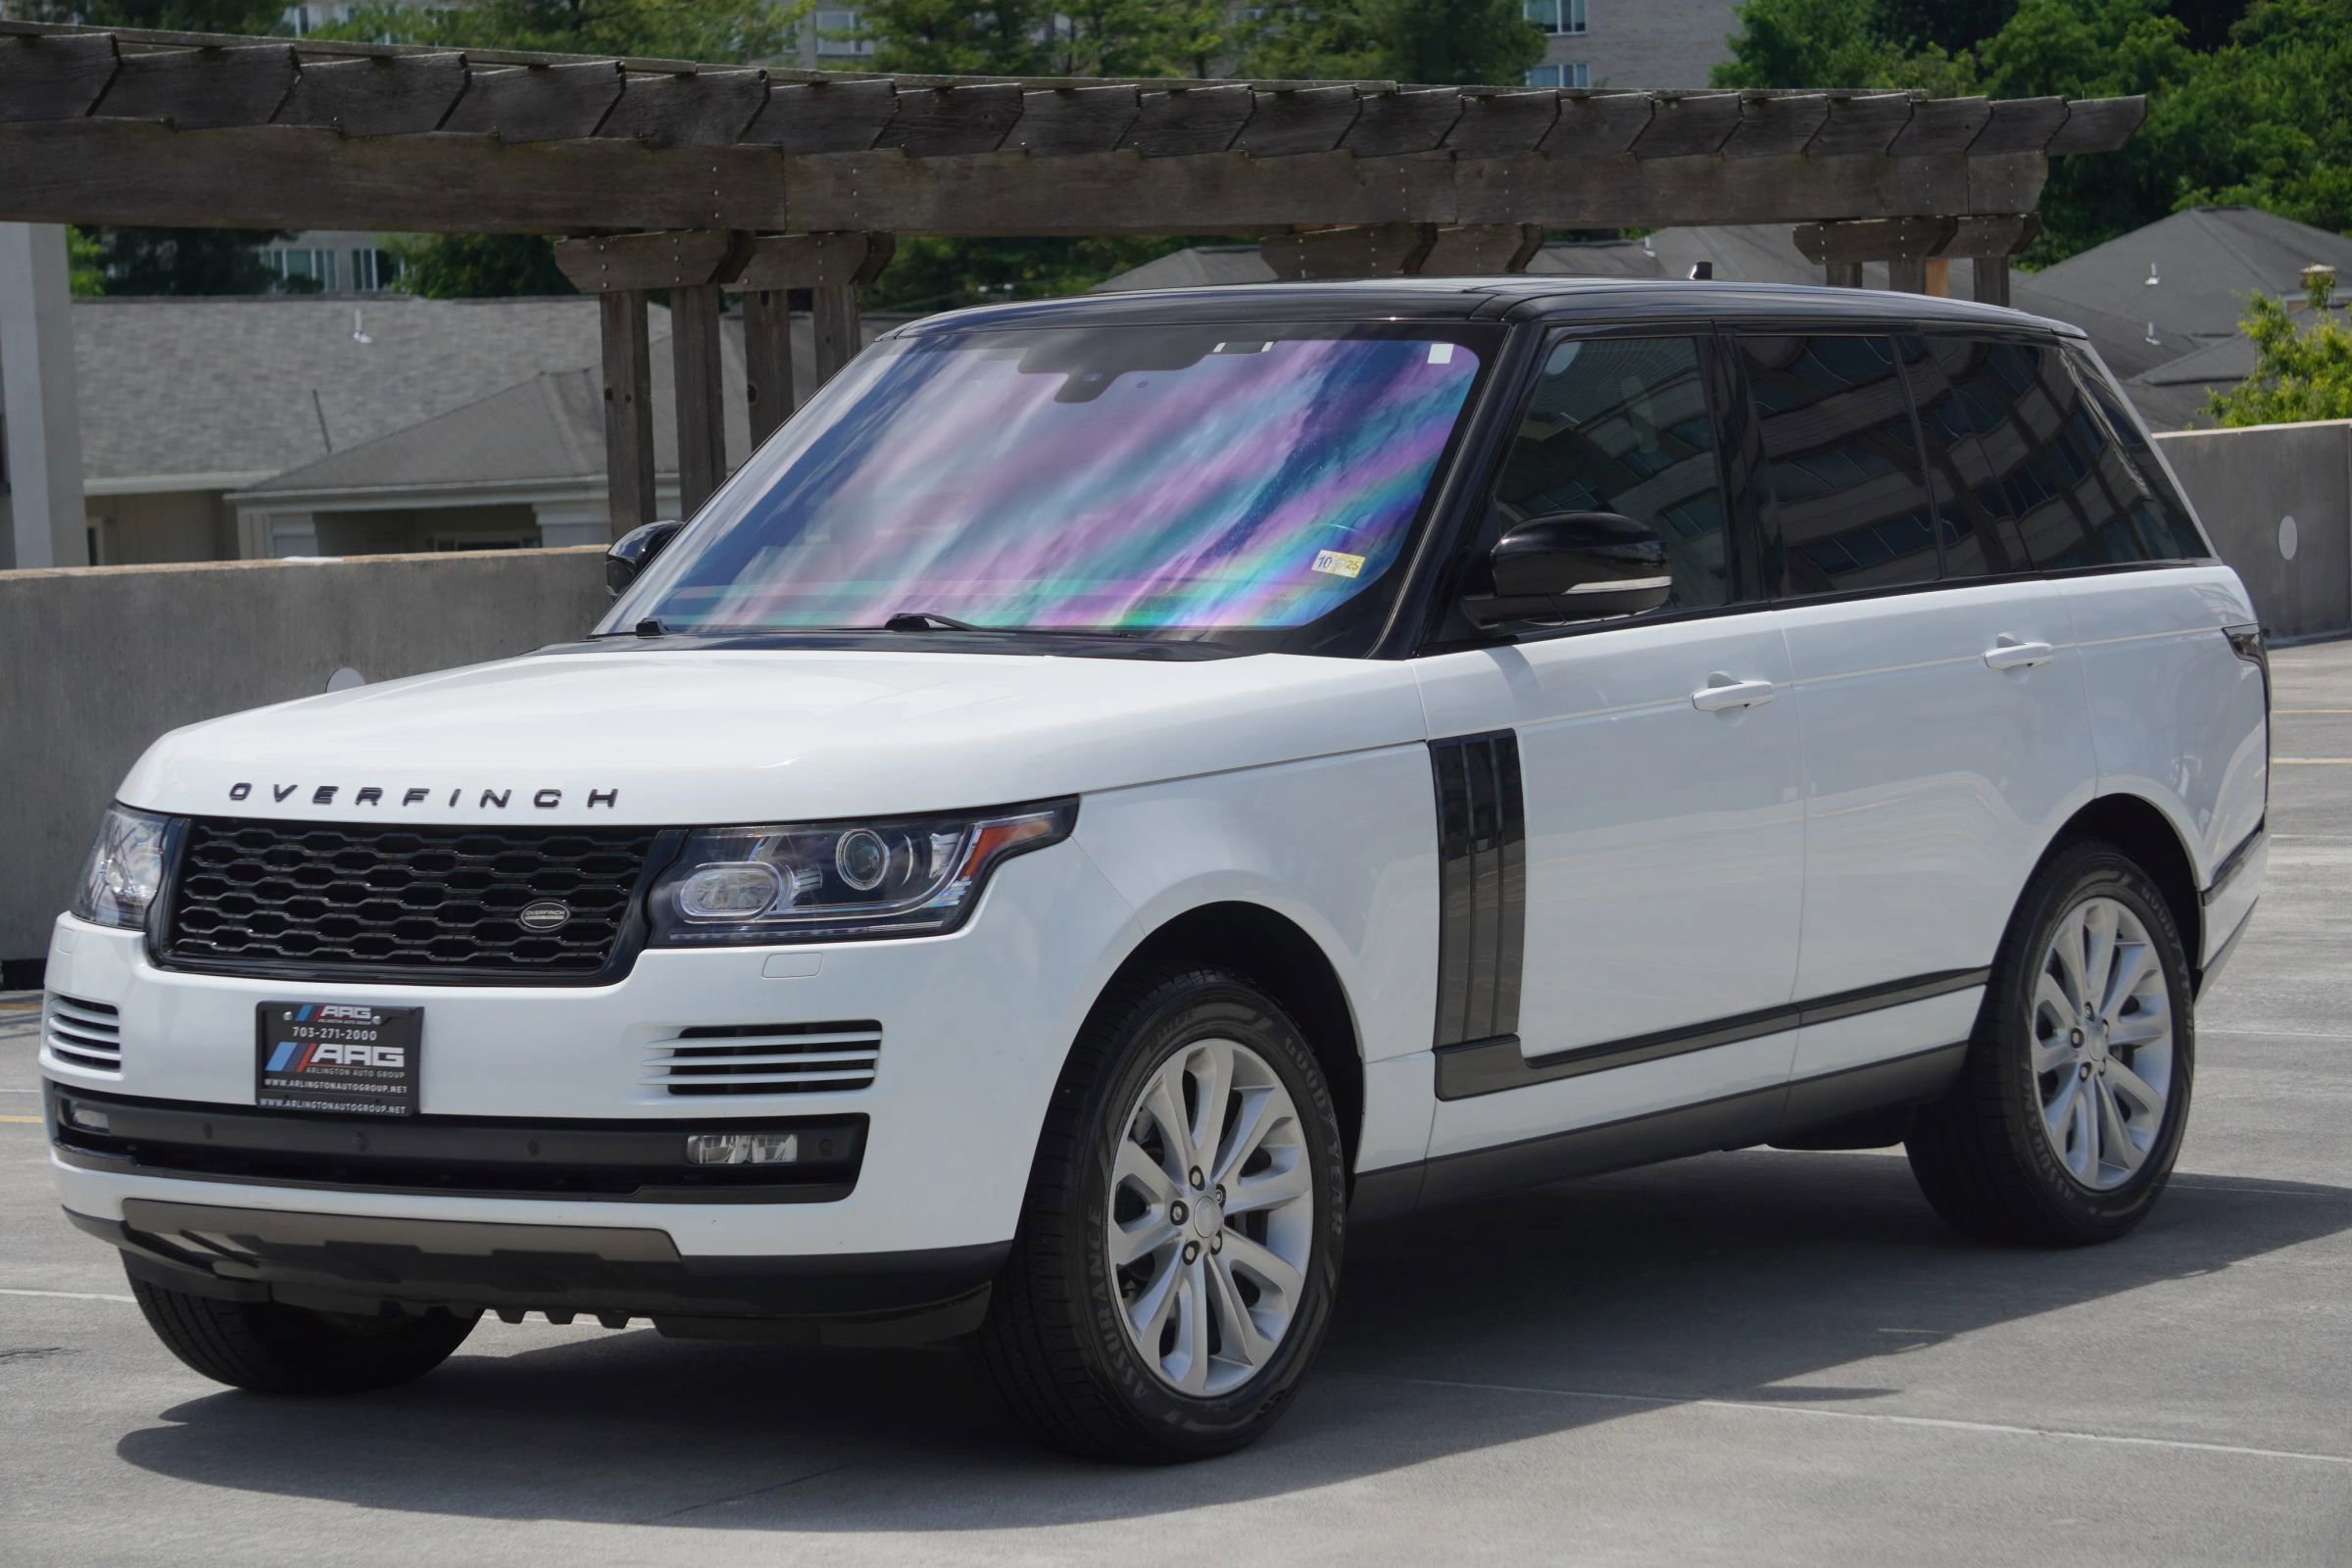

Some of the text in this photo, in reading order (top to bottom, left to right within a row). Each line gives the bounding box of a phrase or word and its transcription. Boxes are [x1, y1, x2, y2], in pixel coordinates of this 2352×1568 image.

[1317, 556, 1359, 571] 10 25
[228, 782, 619, 808] OVERFINCH
[319, 1004, 371, 1019] AAG
[292, 1026, 377, 1041] 703-271-2000
[310, 1043, 405, 1067] AAG
[306, 1066, 406, 1079] ARLINGTON AUTO GROUP
[264, 1078, 408, 1094] WWW.ARLINGTONAUTOGROUP.NET
[259, 1098, 407, 1114] WWW.ARLINGTONAUTOGROUP.NET
[1086, 1203, 1150, 1399] ASSURANCE
